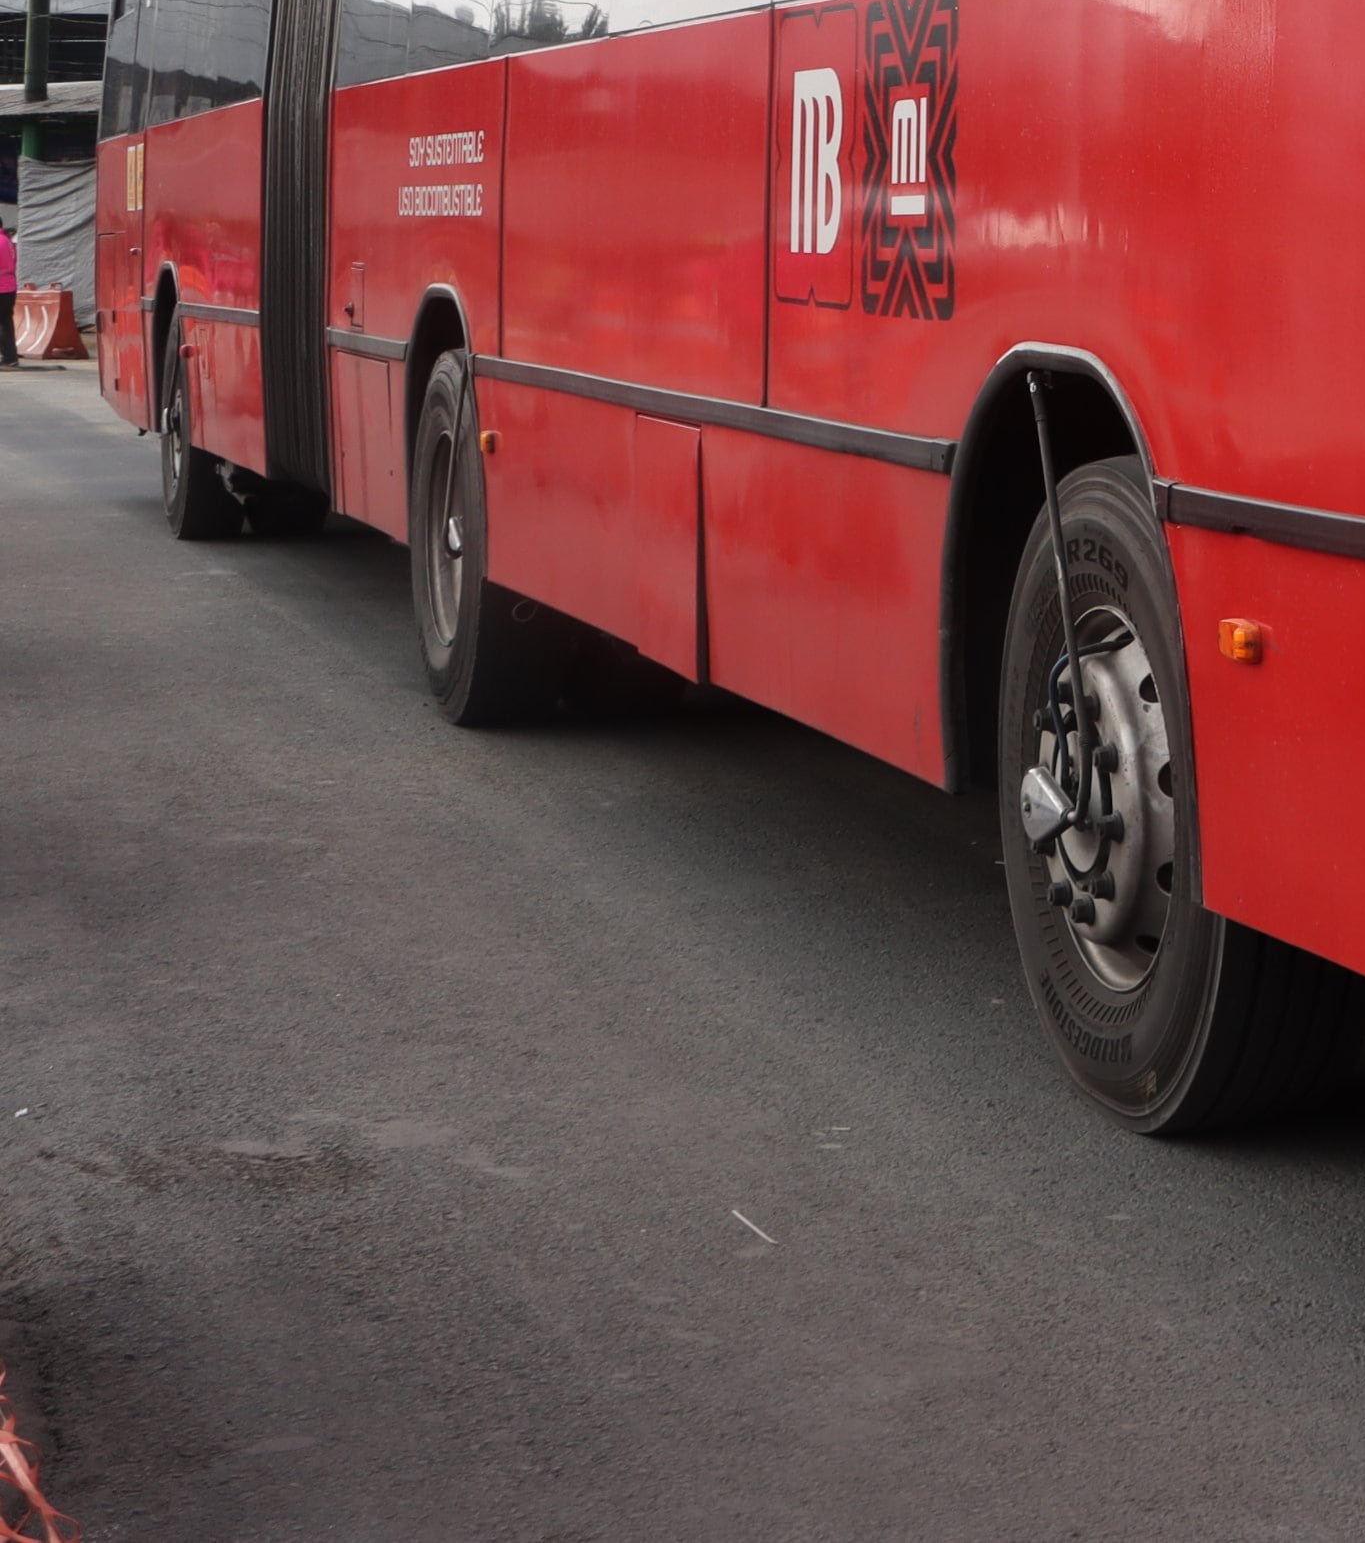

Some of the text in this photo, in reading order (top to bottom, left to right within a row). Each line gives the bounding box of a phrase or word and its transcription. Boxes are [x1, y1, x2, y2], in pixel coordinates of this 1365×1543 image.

[408, 130, 484, 167] SOY SUSTENTABLE
[398, 184, 483, 216] USO BIOCOMBUSTIBLE
[1039, 968, 1135, 1064] BRIDGESTONE
